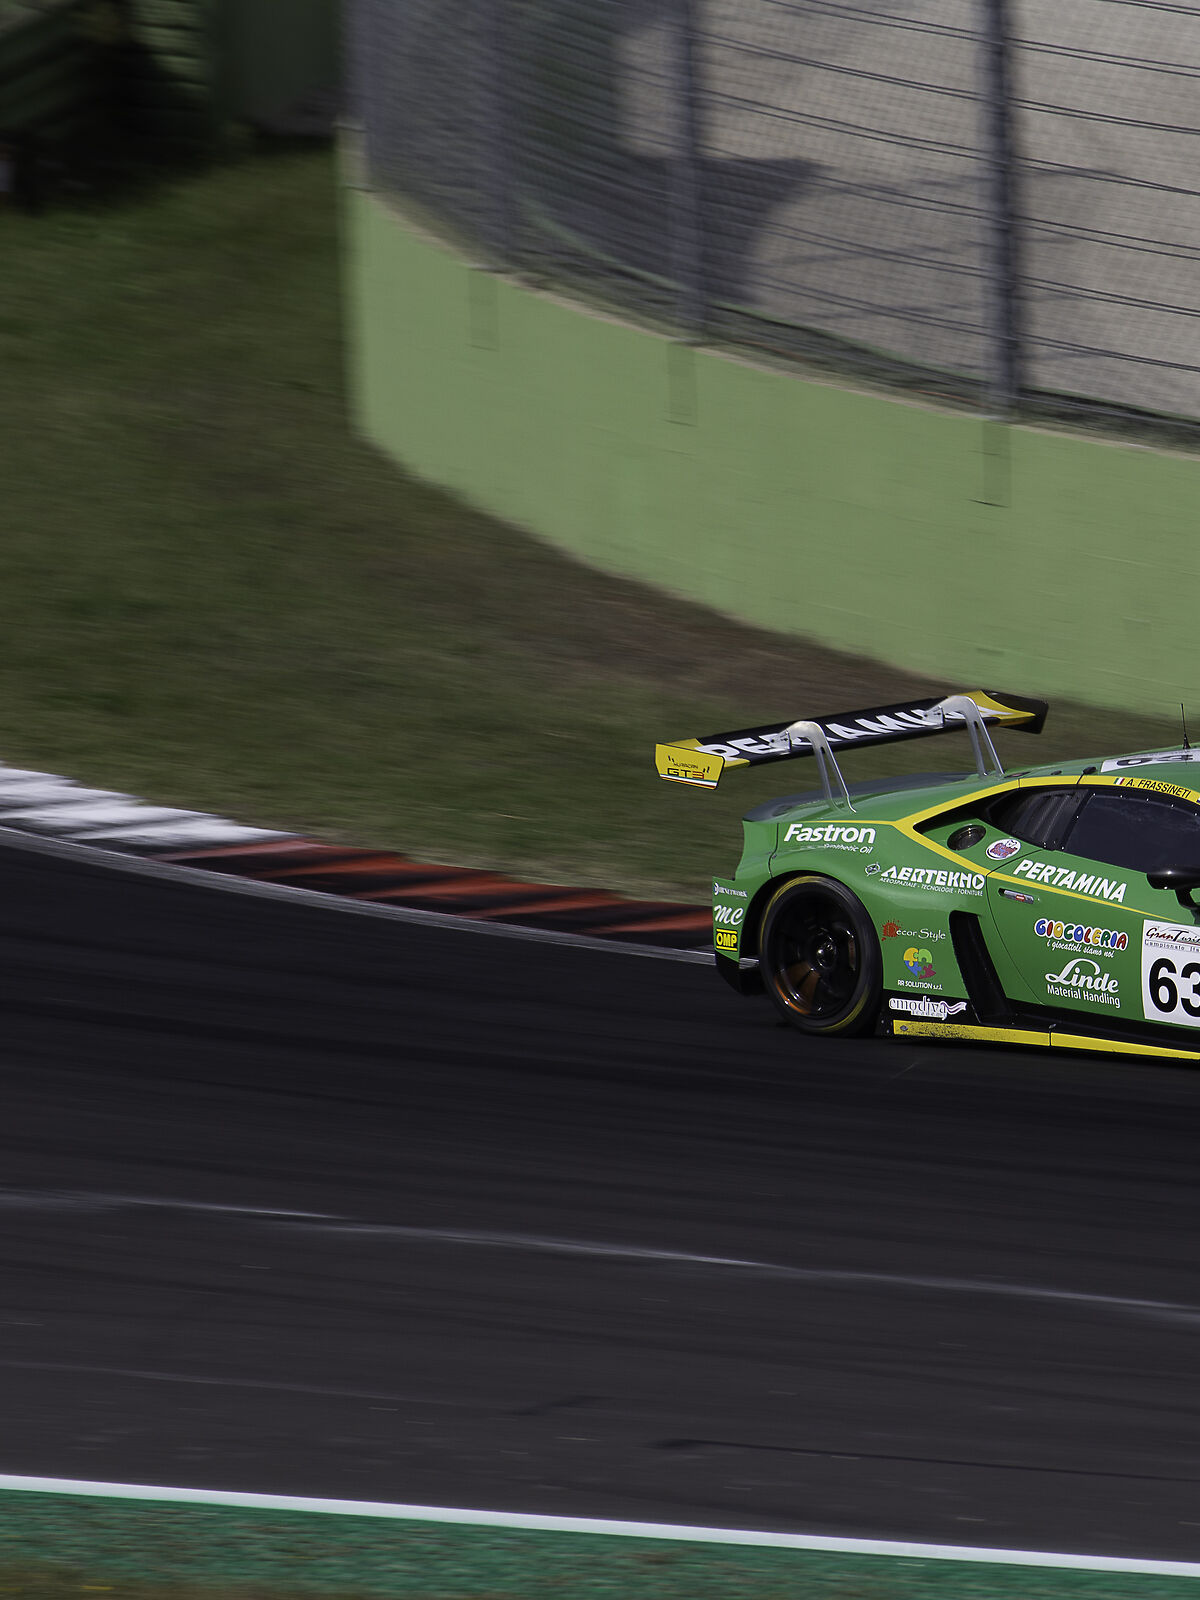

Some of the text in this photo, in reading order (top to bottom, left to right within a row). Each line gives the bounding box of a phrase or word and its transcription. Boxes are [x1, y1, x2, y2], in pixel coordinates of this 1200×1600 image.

[695, 706, 1014, 761] PEAMIA
[667, 767, 705, 779] GT3
[1125, 779, 1192, 799] A. FRASSINETI
[783, 823, 876, 844] Fastron
[860, 846, 873, 854] Oil
[879, 877, 983, 897] AEROSPAZIALE TECNOLOGIE FORNITURE
[881, 865, 985, 890] AERTEKNO
[1013, 859, 1127, 902] PERTAMINA
[716, 932, 738, 947] OMP
[918, 928, 946, 942] Style
[1034, 918, 1129, 951] GIOCOLERIA
[1052, 940, 1082, 952] giocattoli
[1083, 946, 1102, 956] siamo
[1104, 950, 1115, 958] noi
[905, 980, 933, 990] SOLUTION
[1045, 958, 1119, 993] Linde
[1047, 983, 1121, 1009] Material Handling
